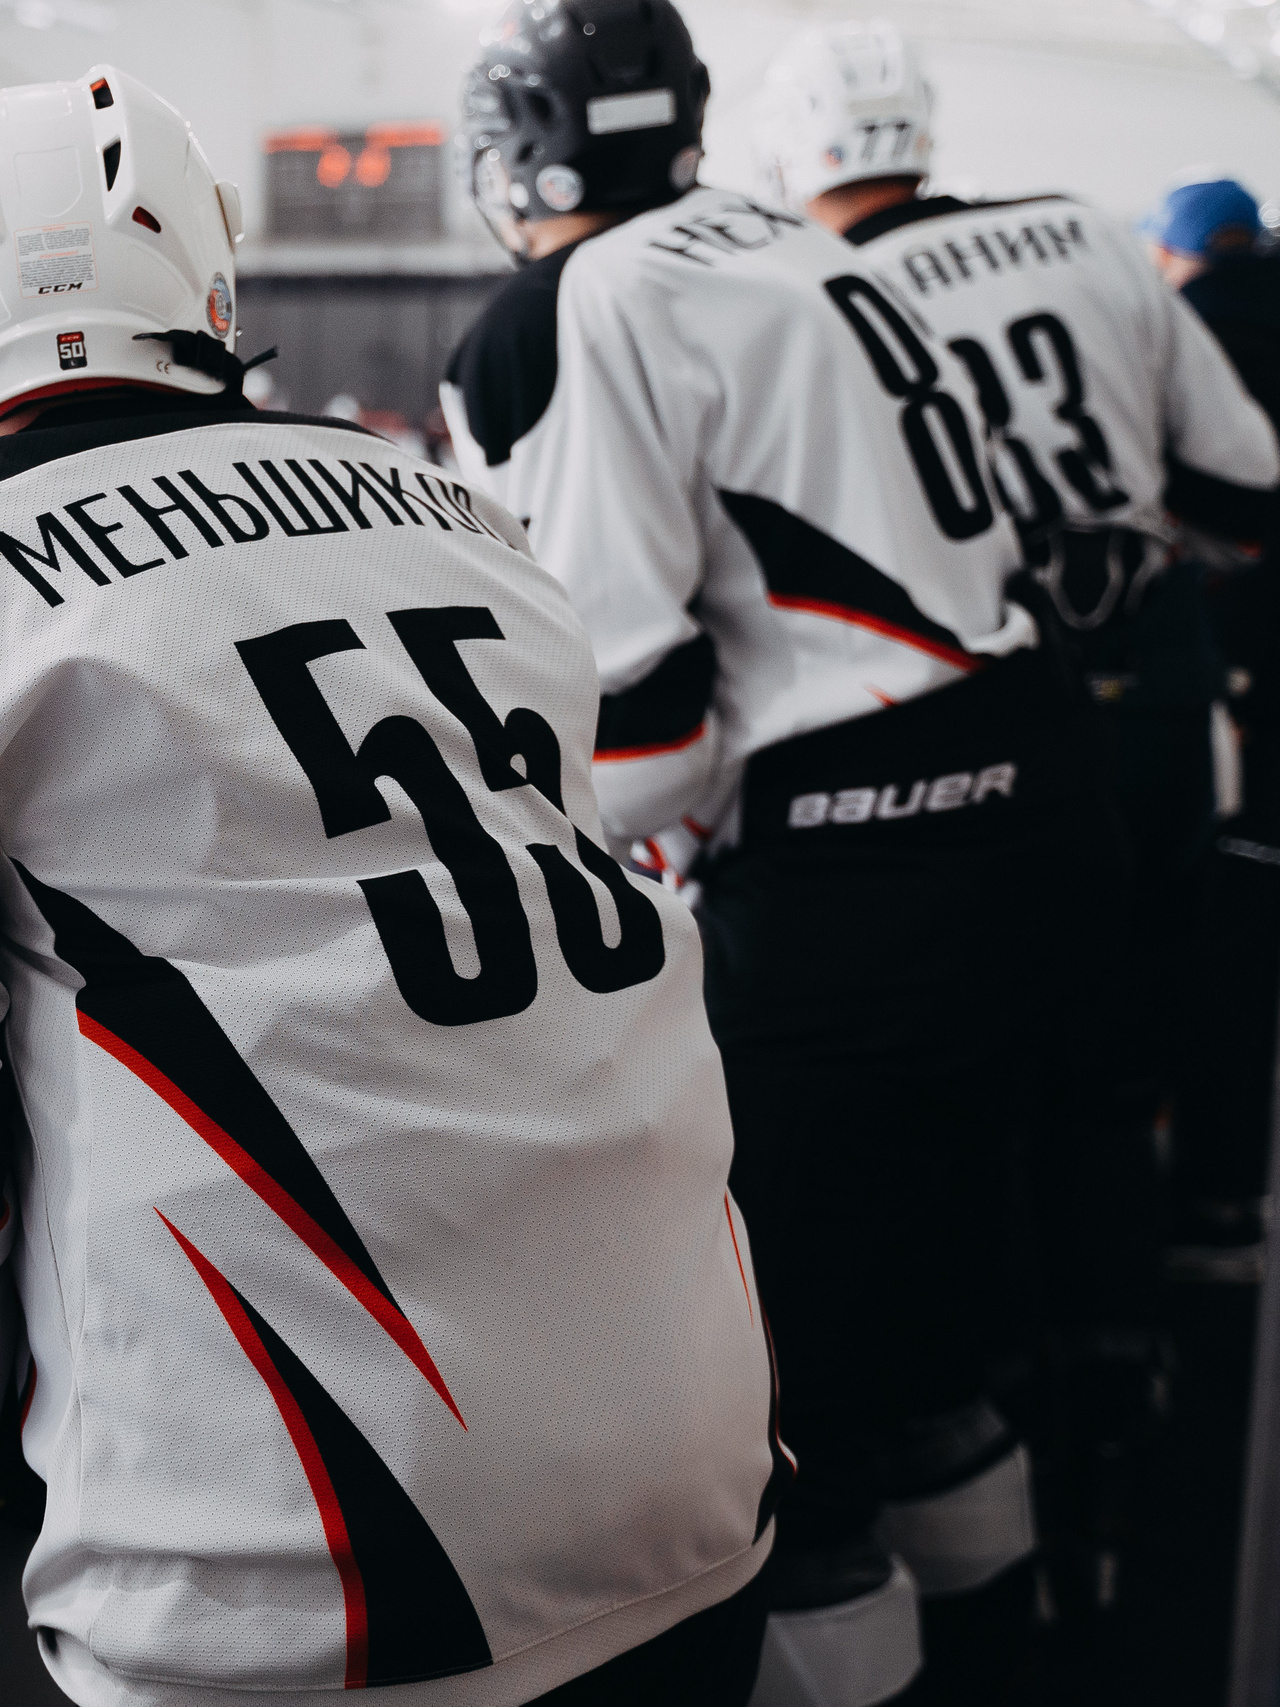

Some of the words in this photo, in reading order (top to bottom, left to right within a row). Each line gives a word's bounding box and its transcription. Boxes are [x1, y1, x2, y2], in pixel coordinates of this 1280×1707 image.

[38, 282, 83, 295] CCM
[60, 342, 84, 359] 50
[788, 762, 1016, 828] BAUER
[234, 606, 665, 1026] 55
